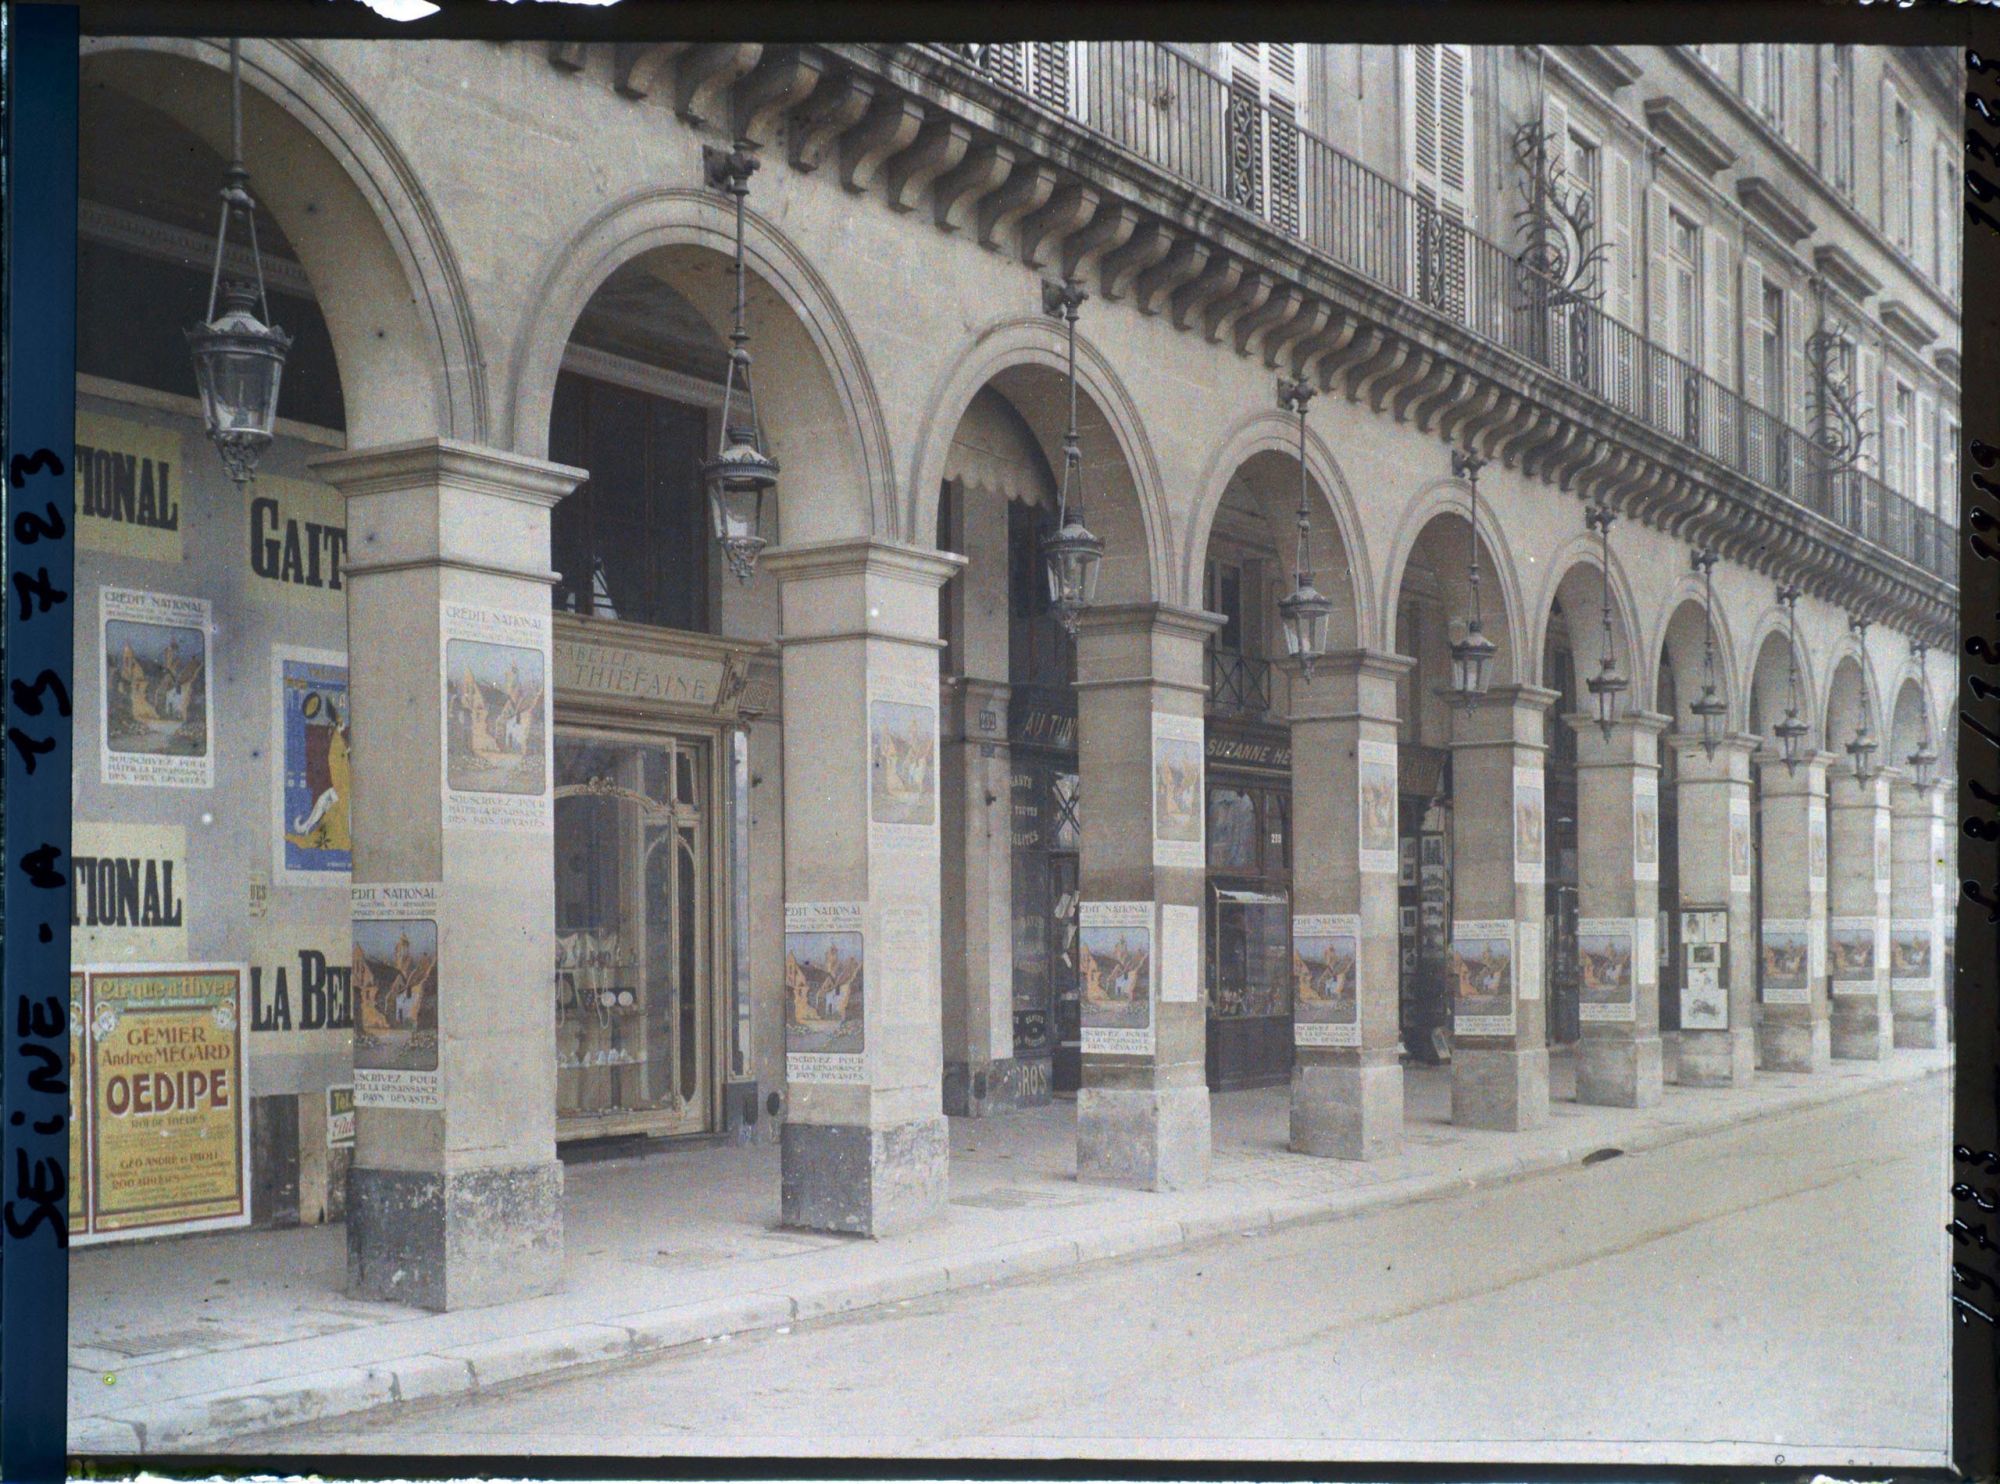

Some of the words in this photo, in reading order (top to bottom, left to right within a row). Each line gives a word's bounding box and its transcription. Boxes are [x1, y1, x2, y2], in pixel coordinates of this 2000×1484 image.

[251, 497, 347, 591] GAIT
[1206, 739, 1270, 762] SUZANNE
[20, 843, 67, 889] A
[382, 887, 437, 900] NATIONAL
[814, 905, 862, 916] NATIONAL
[251, 966, 292, 1031] LA
[106, 1068, 229, 1116] OEDIPE
